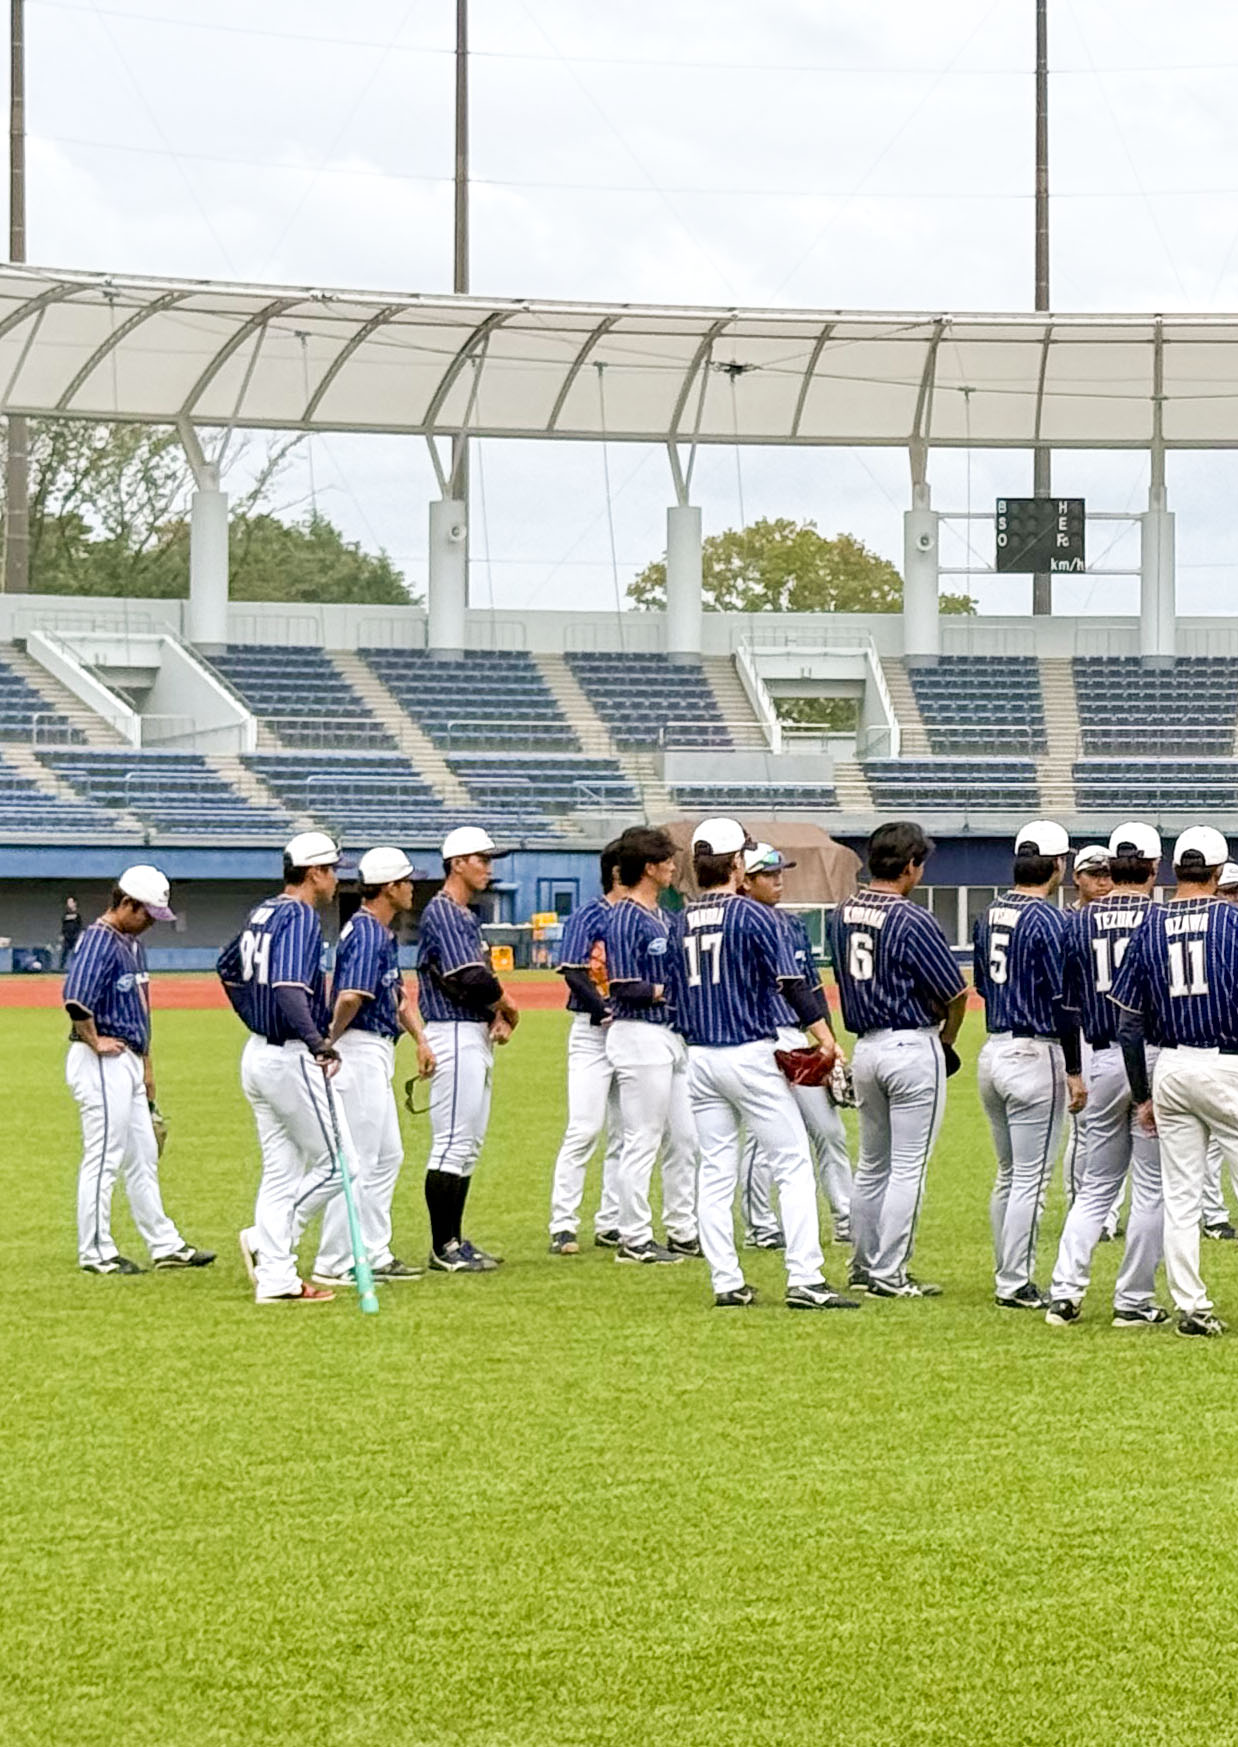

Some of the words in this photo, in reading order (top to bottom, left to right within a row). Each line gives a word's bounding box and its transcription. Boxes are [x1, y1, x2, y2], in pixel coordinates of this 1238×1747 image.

[998, 501, 1007, 514] B
[1058, 501, 1068, 514] H
[998, 517, 1007, 530] S
[1058, 517, 1068, 531] E
[998, 533, 1008, 547] O
[1050, 557, 1085, 571] km/h
[683, 931, 724, 988] 17
[850, 931, 873, 981] 6
[990, 932, 1010, 985] 5
[1168, 940, 1209, 998] 11
